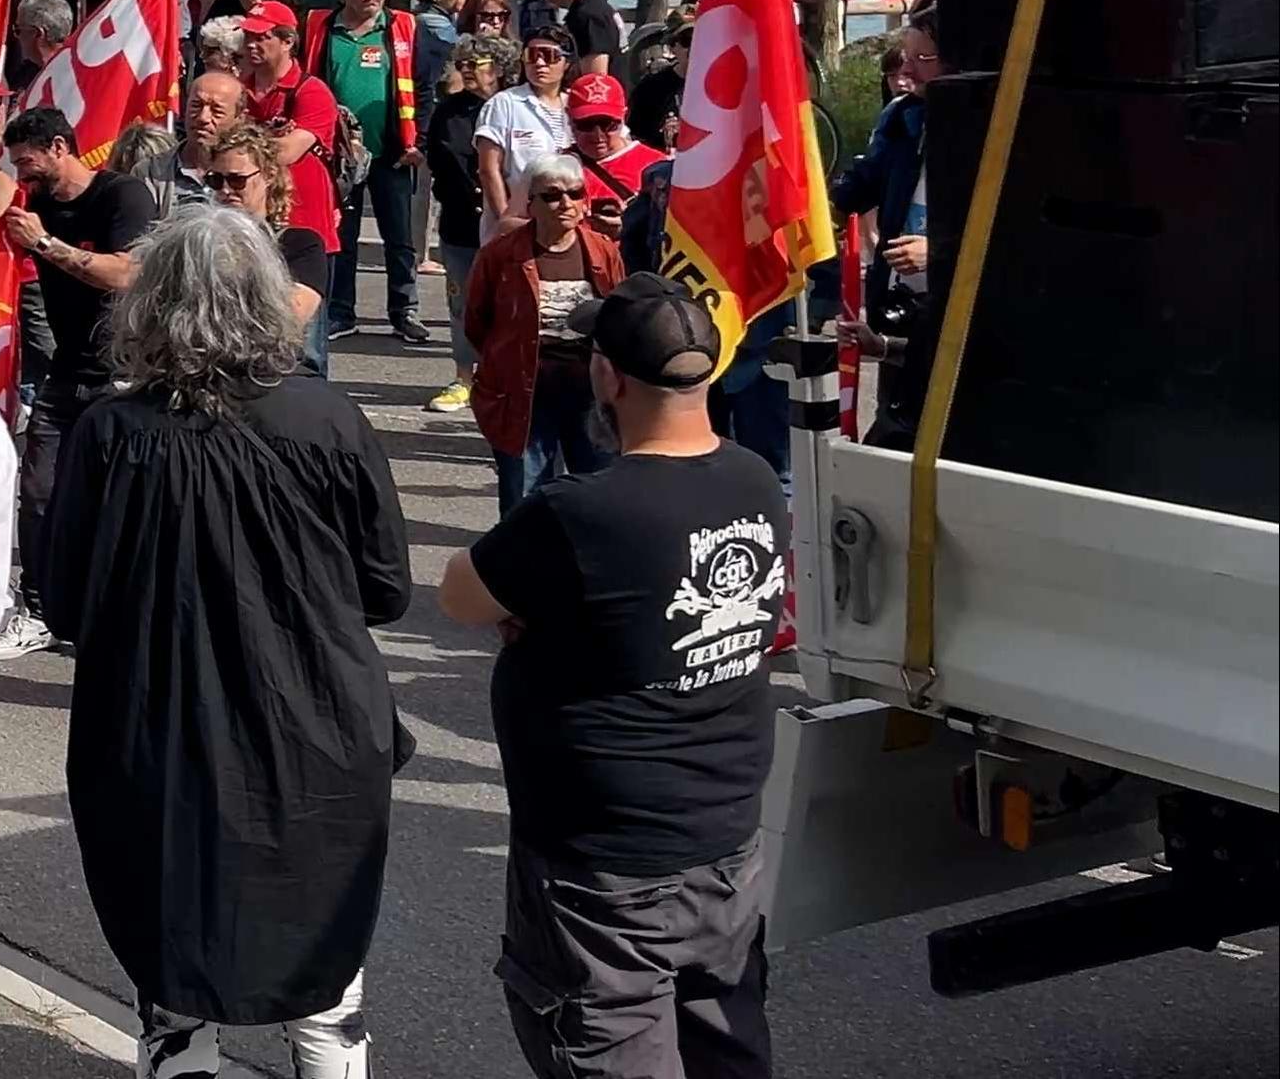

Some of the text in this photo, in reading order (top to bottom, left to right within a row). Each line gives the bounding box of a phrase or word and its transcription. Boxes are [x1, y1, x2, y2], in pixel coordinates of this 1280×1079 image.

[689, 513, 774, 577] Pétrochimie
[714, 555, 751, 587] cgt
[689, 631, 760, 663] LAVERA
